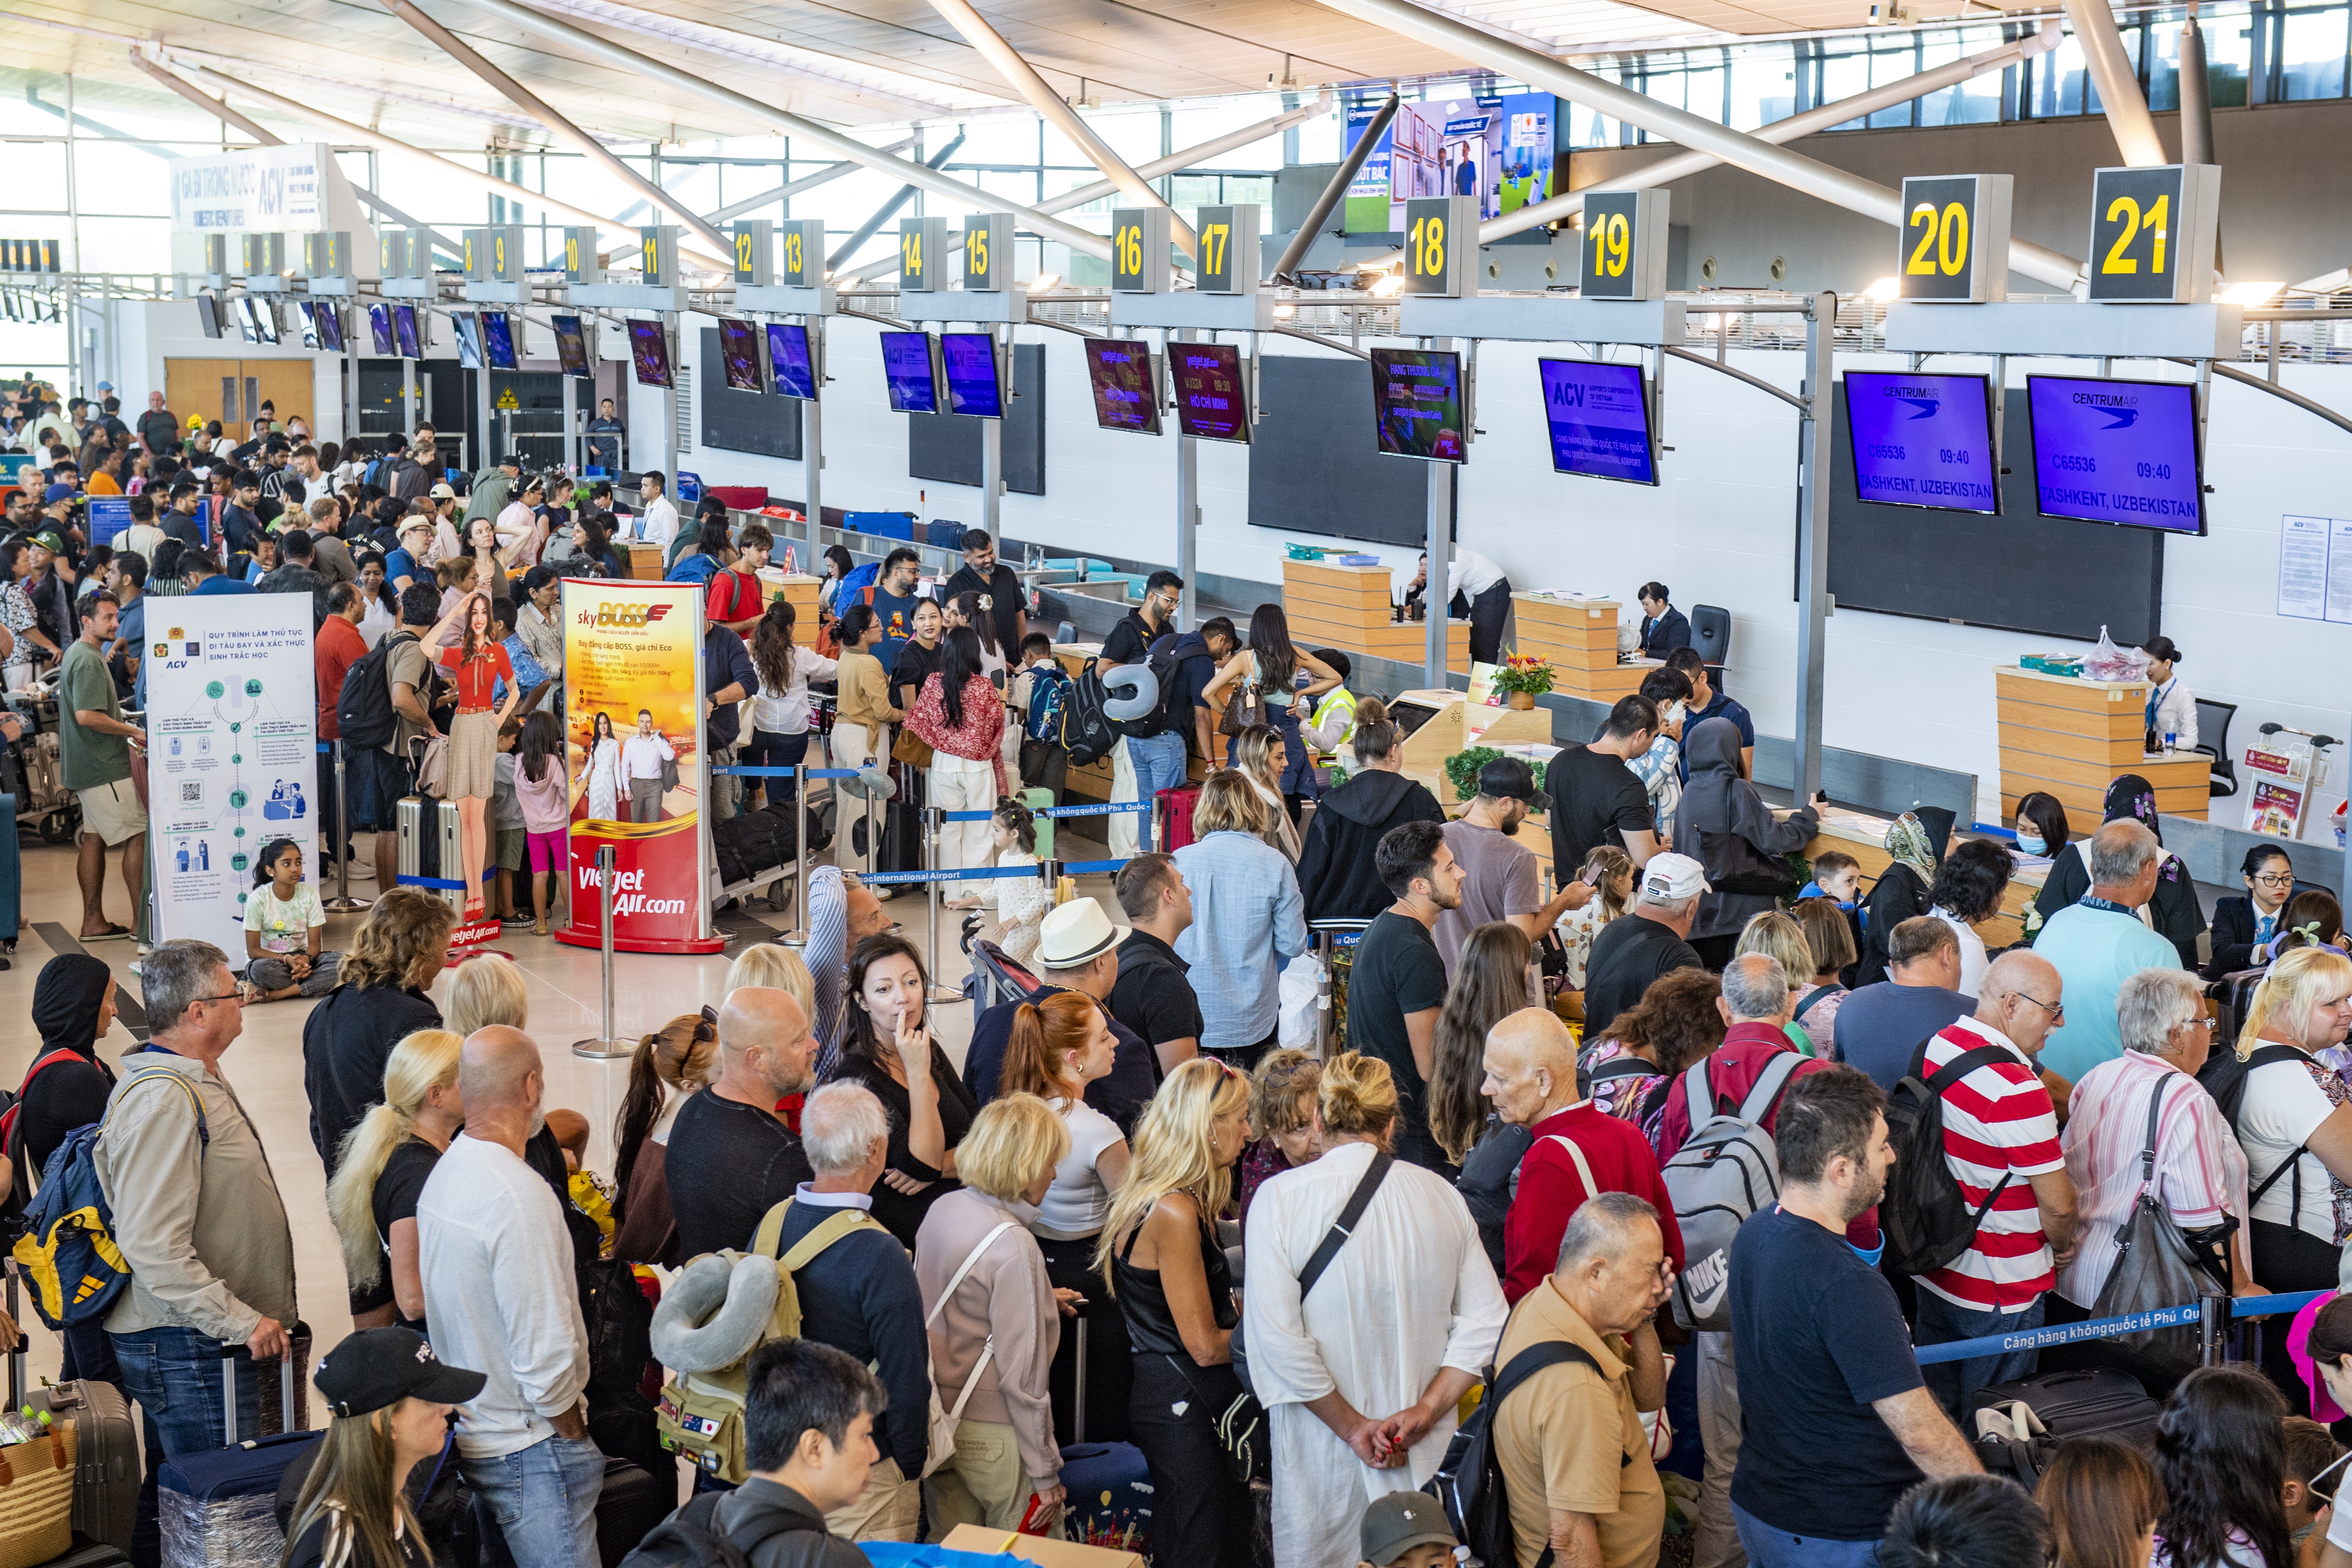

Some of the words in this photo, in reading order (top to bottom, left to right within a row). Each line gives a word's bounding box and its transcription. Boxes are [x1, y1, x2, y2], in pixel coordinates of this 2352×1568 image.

[182, 170, 192, 199] GA
[203, 165, 229, 197] TRONG
[258, 168, 285, 214] ACV
[1410, 217, 1444, 276] 18
[1589, 213, 1629, 277] 19
[1906, 202, 1968, 276] 20
[2101, 195, 2169, 274] 21
[264, 240, 270, 267] 3
[307, 241, 312, 269] 4
[329, 240, 335, 269] 5
[382, 239, 388, 269] 6
[407, 238, 413, 268] 7
[465, 239, 472, 272] 8
[496, 237, 504, 273] 9
[566, 238, 578, 272] 10
[644, 238, 658, 274] 11
[736, 234, 752, 272] 12
[786, 233, 801, 273] 13
[902, 233, 922, 276] 14
[967, 230, 987, 275] 15
[1116, 226, 1141, 275] 16
[1202, 224, 1229, 275] 17
[949, 349, 965, 367] ACV
[1390, 364, 1405, 377] HẠNG
[1431, 367, 1440, 377] GIA
[1184, 377, 1202, 389] VJ324
[1214, 380, 1231, 392] 09:30
[1554, 382, 1584, 407] ACV
[1608, 387, 1633, 395] CORPORATION
[1883, 386, 1939, 398] CENTRUMAIR
[1190, 393, 1199, 407] HỒ
[1212, 397, 1228, 410] MINH
[2073, 392, 2137, 408] CENTRUMAIR
[1569, 434, 1581, 445] HÀNG
[1582, 436, 1598, 447] KHÔNG
[1599, 438, 1612, 449] QUỐC
[1630, 442, 1644, 453] QUỐC
[1868, 444, 1905, 460] C65536
[1940, 449, 1969, 464] 09:40
[1563, 449, 1571, 458] PHU
[1572, 451, 1584, 460] QUOC
[1586, 452, 1620, 464] INTERNATIONAL
[1621, 457, 1641, 467] AIRPORT
[2053, 454, 2095, 473] C65536
[2137, 462, 2170, 480] 09:40
[1859, 475, 1918, 494] TASHKENT,
[1920, 479, 1991, 499] UZBEKISTAN
[2040, 486, 2109, 510] TASHKENT,
[2112, 494, 2195, 518] UZBEKISTAN
[220, 641, 234, 649] TÀU
[230, 650, 249, 658] TRẮC
[252, 652, 268, 660] HỌC
[589, 640, 601, 649] đẳng
[604, 641, 613, 650] cấp
[166, 661, 187, 669] ACV
[1126, 801, 1145, 810] Quốc
[579, 867, 645, 895] Vijet
[930, 872, 960, 880] Airport
[613, 894, 685, 916] Air.com
[2082, 895, 2112, 909] DNM
[1685, 1248, 1728, 1296] NIKE
[2003, 1331, 2036, 1350] Cảng
[2038, 1326, 2066, 1347] hàng
[2140, 1313, 2151, 1330] tế
[2154, 1309, 2176, 1327] Phú
[2183, 1306, 2199, 1322] Qu
